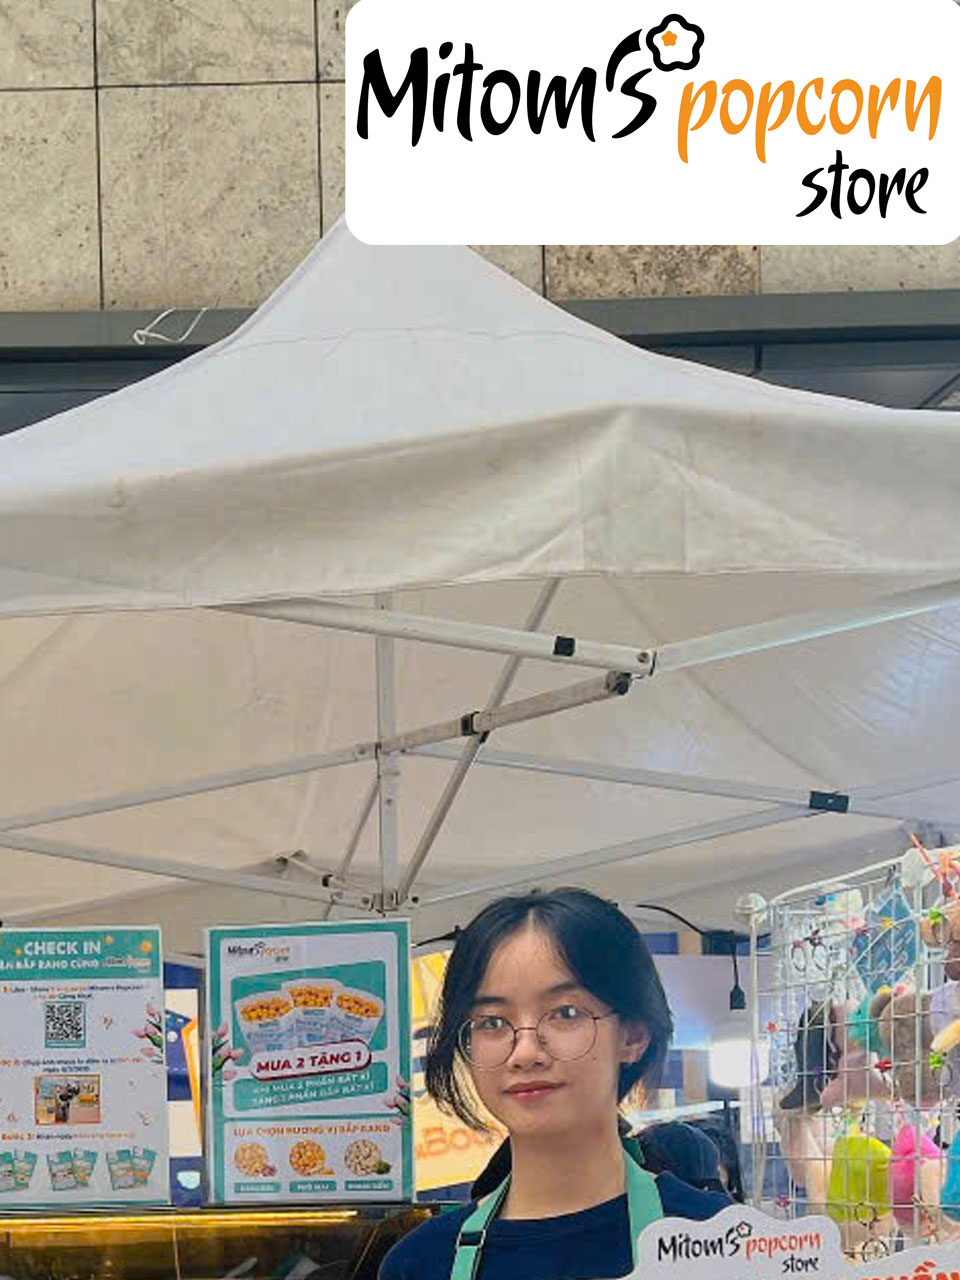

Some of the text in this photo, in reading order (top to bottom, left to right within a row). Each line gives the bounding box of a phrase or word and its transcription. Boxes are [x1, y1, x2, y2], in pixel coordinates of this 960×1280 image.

[24, 941, 102, 956] CHECK IN
[257, 1051, 362, 1073] MUA 2 TẶNG 1
[745, 1231, 820, 1260] popcorn
[783, 1254, 819, 1274] store
